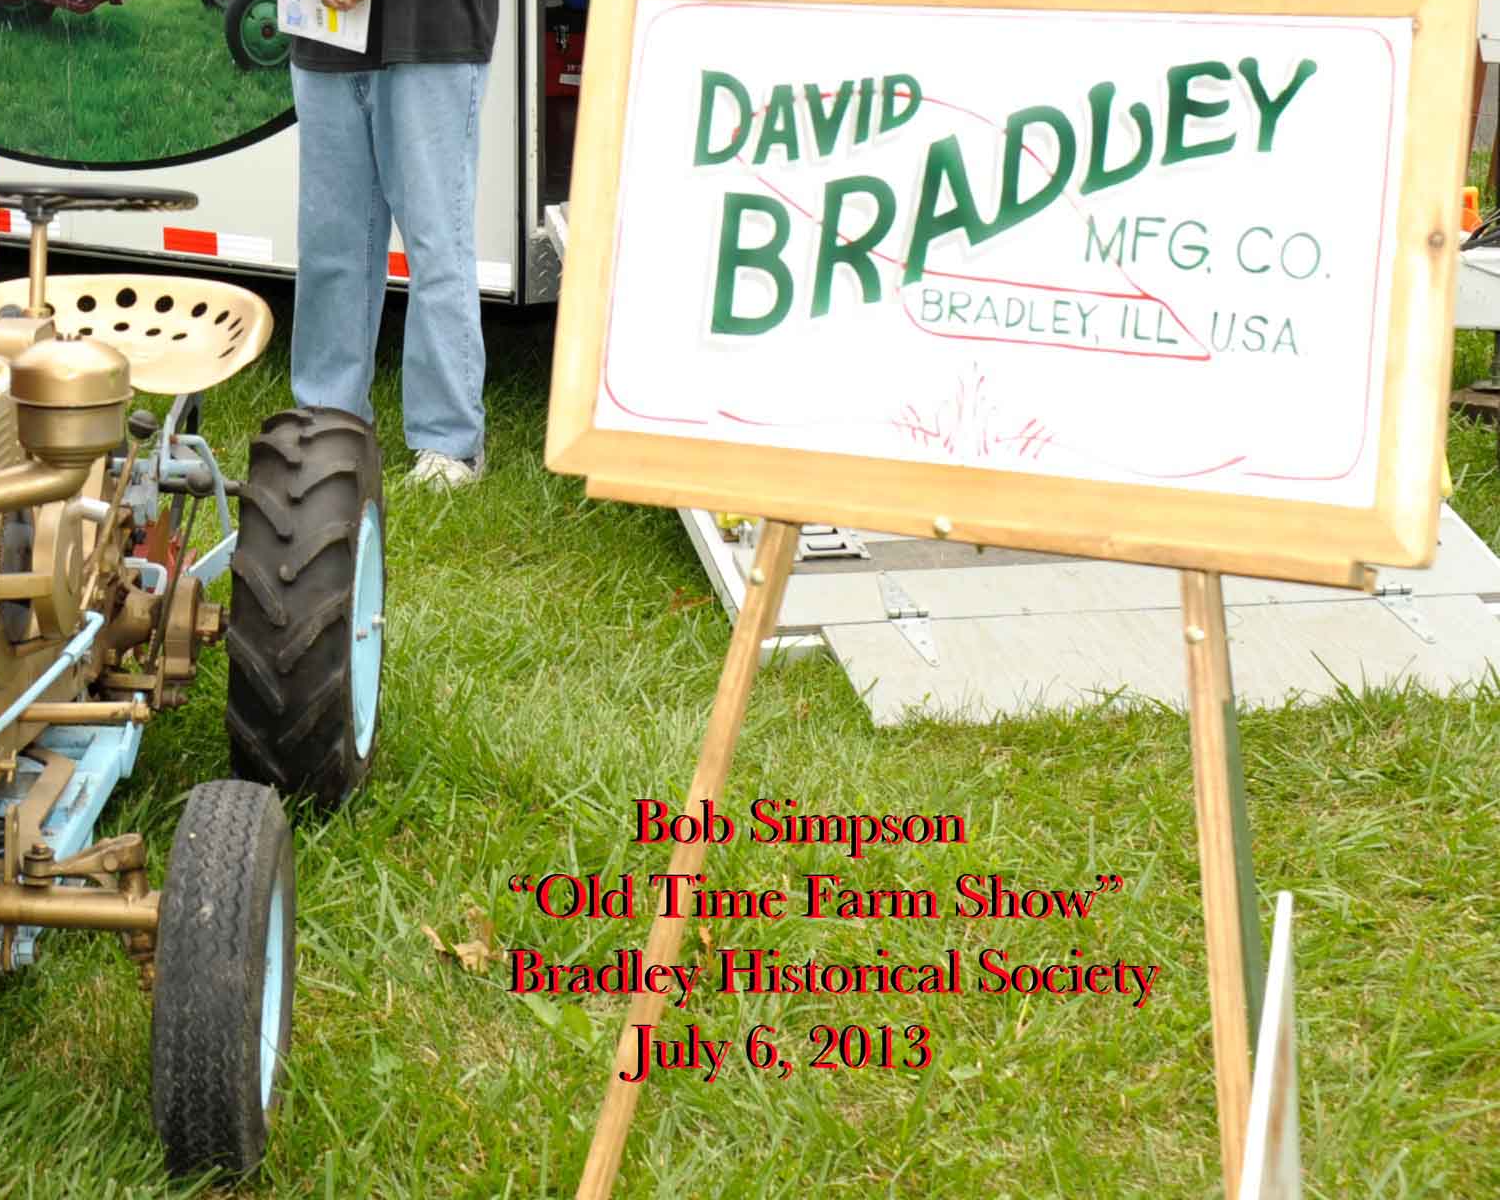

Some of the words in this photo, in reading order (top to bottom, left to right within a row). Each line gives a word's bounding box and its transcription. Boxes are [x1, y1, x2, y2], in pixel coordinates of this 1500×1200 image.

[694, 69, 922, 166] DAVID
[711, 57, 1317, 335] BRADLEY
[1237, 227, 1332, 280] CO.
[920, 288, 1100, 344] BRADLEY,
